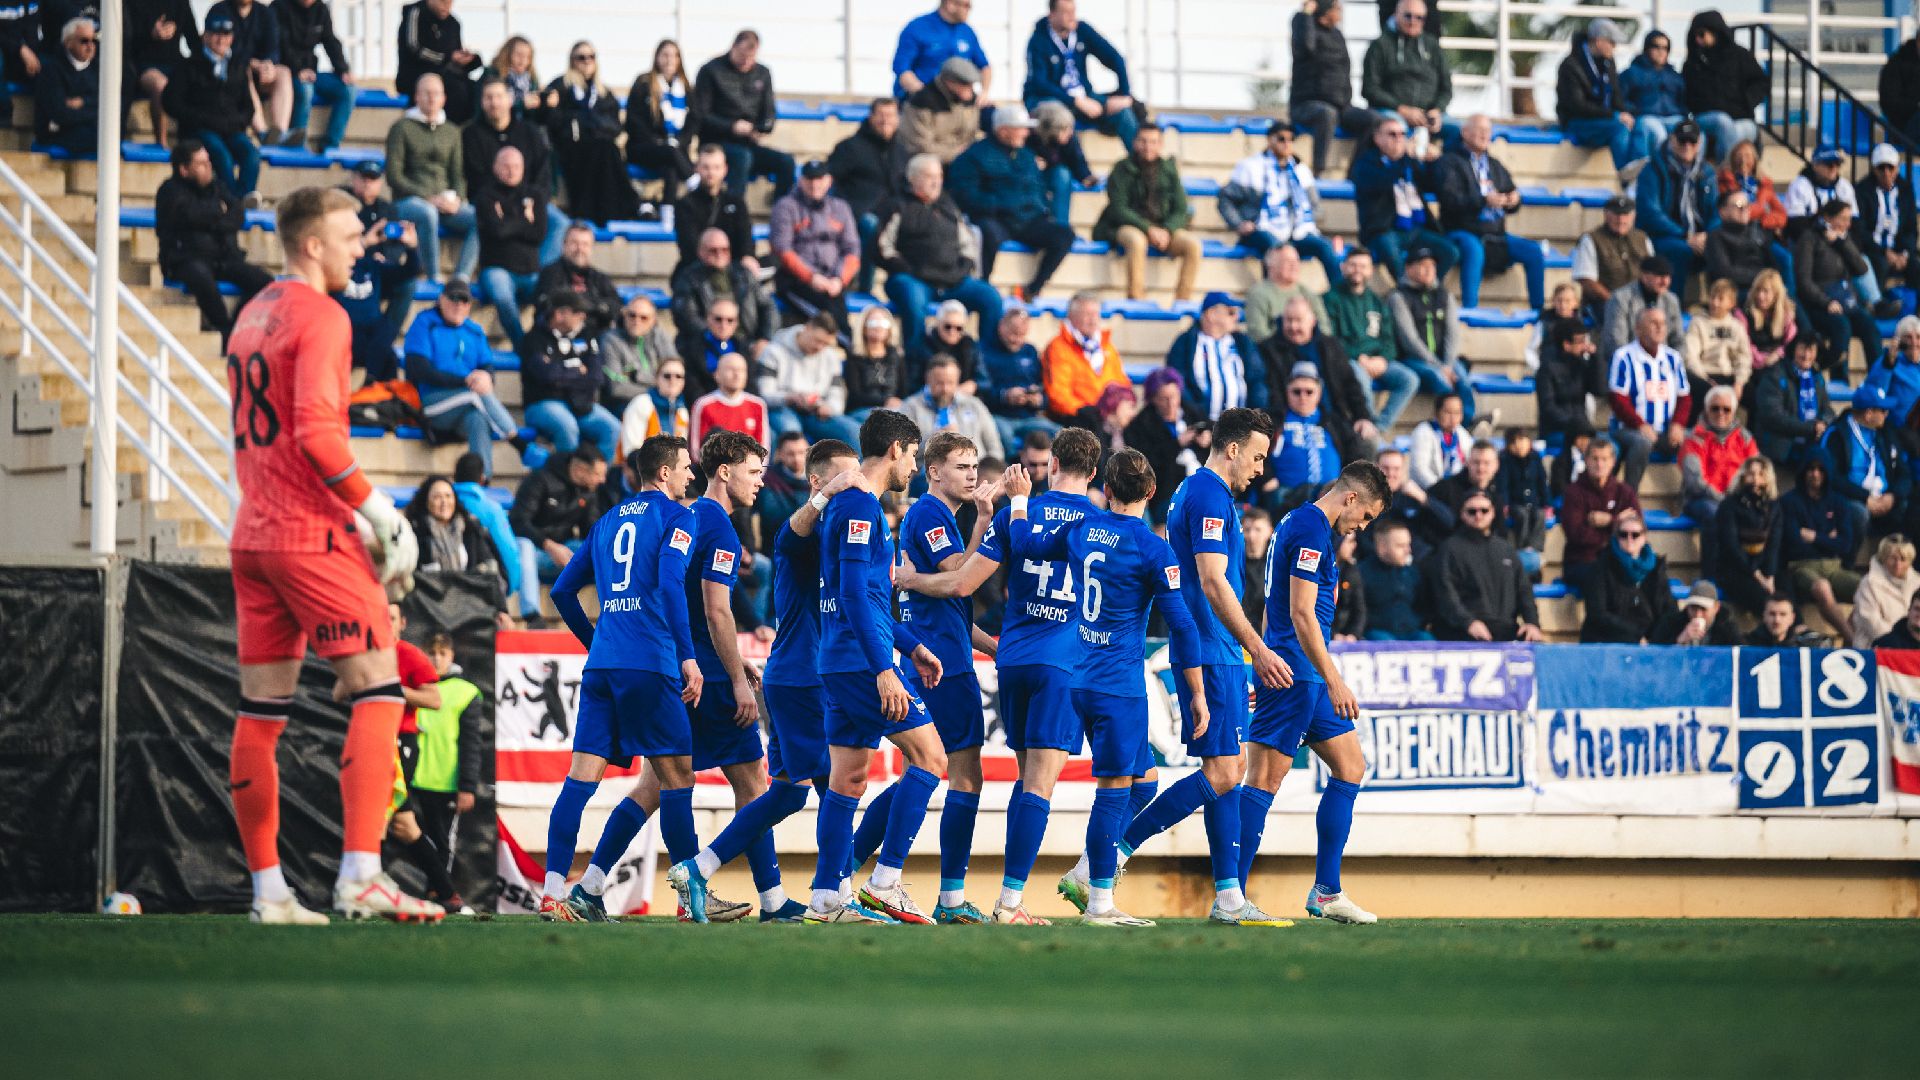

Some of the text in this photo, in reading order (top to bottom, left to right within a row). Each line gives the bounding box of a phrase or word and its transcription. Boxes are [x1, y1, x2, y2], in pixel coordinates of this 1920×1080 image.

[227, 352, 281, 449] 28
[611, 521, 637, 592] 9
[1082, 551, 1106, 623] 6
[1026, 601, 1069, 623] KLEMENS
[1548, 708, 1734, 779] Chemnitz
